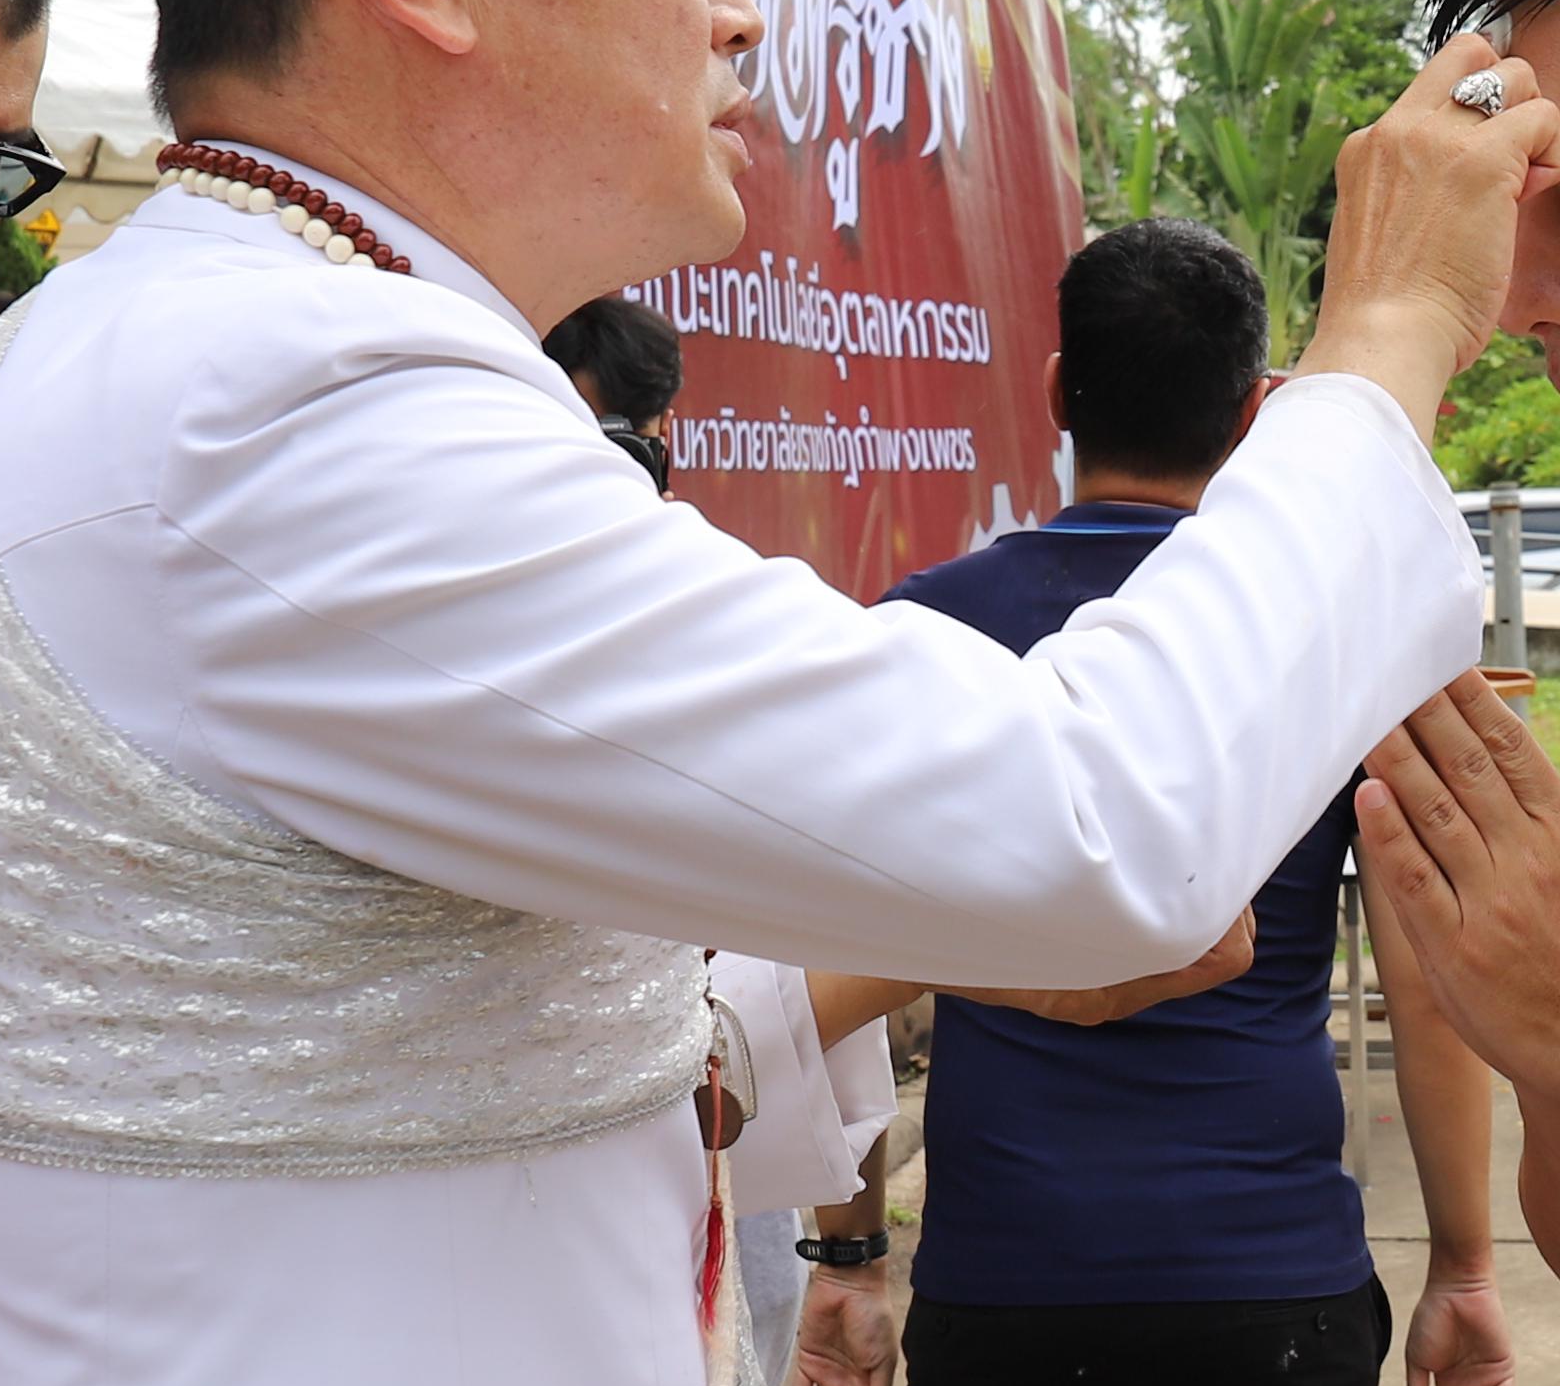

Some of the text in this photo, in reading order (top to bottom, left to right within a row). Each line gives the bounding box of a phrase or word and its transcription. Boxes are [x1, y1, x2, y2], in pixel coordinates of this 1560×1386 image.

[623, 249, 991, 381] ณะเทคโนโลยีอุตสาหกรรม
[671, 404, 977, 488] มหาวิทยาลัยราชภัฏกำแพงเพชร
